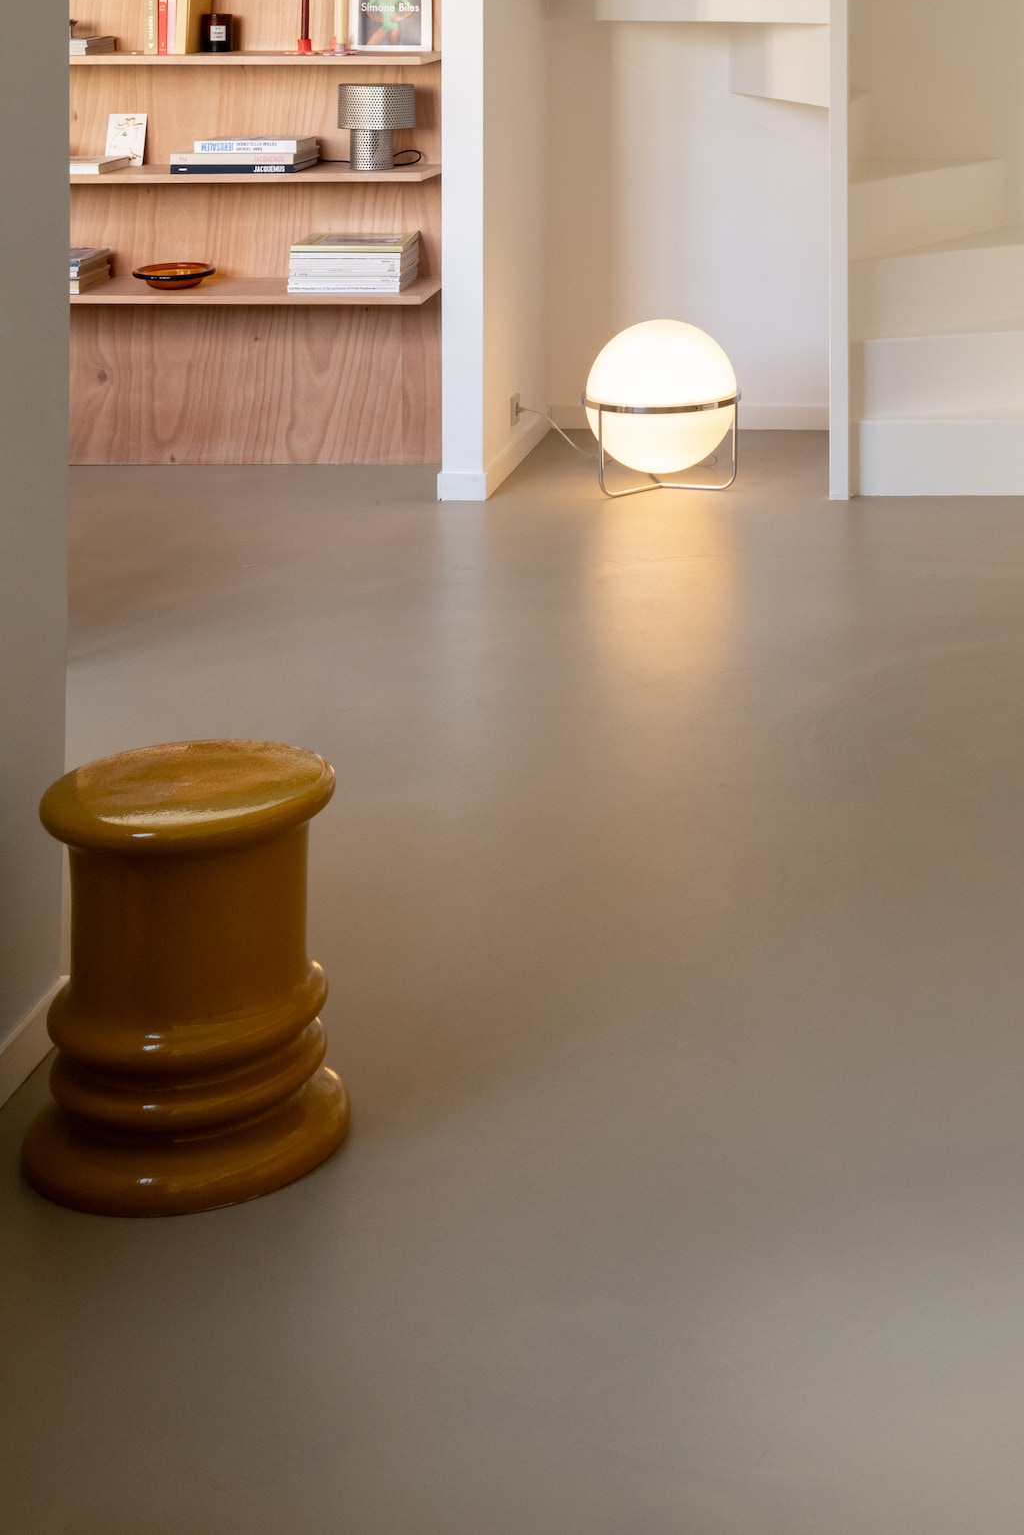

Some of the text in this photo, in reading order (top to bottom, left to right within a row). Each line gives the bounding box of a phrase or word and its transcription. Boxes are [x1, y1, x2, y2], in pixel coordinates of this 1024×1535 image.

[361, 2, 420, 12] Simone Biles
[201, 142, 233, 152] JERUSALEM
[253, 165, 286, 173] JACQUEMUS
